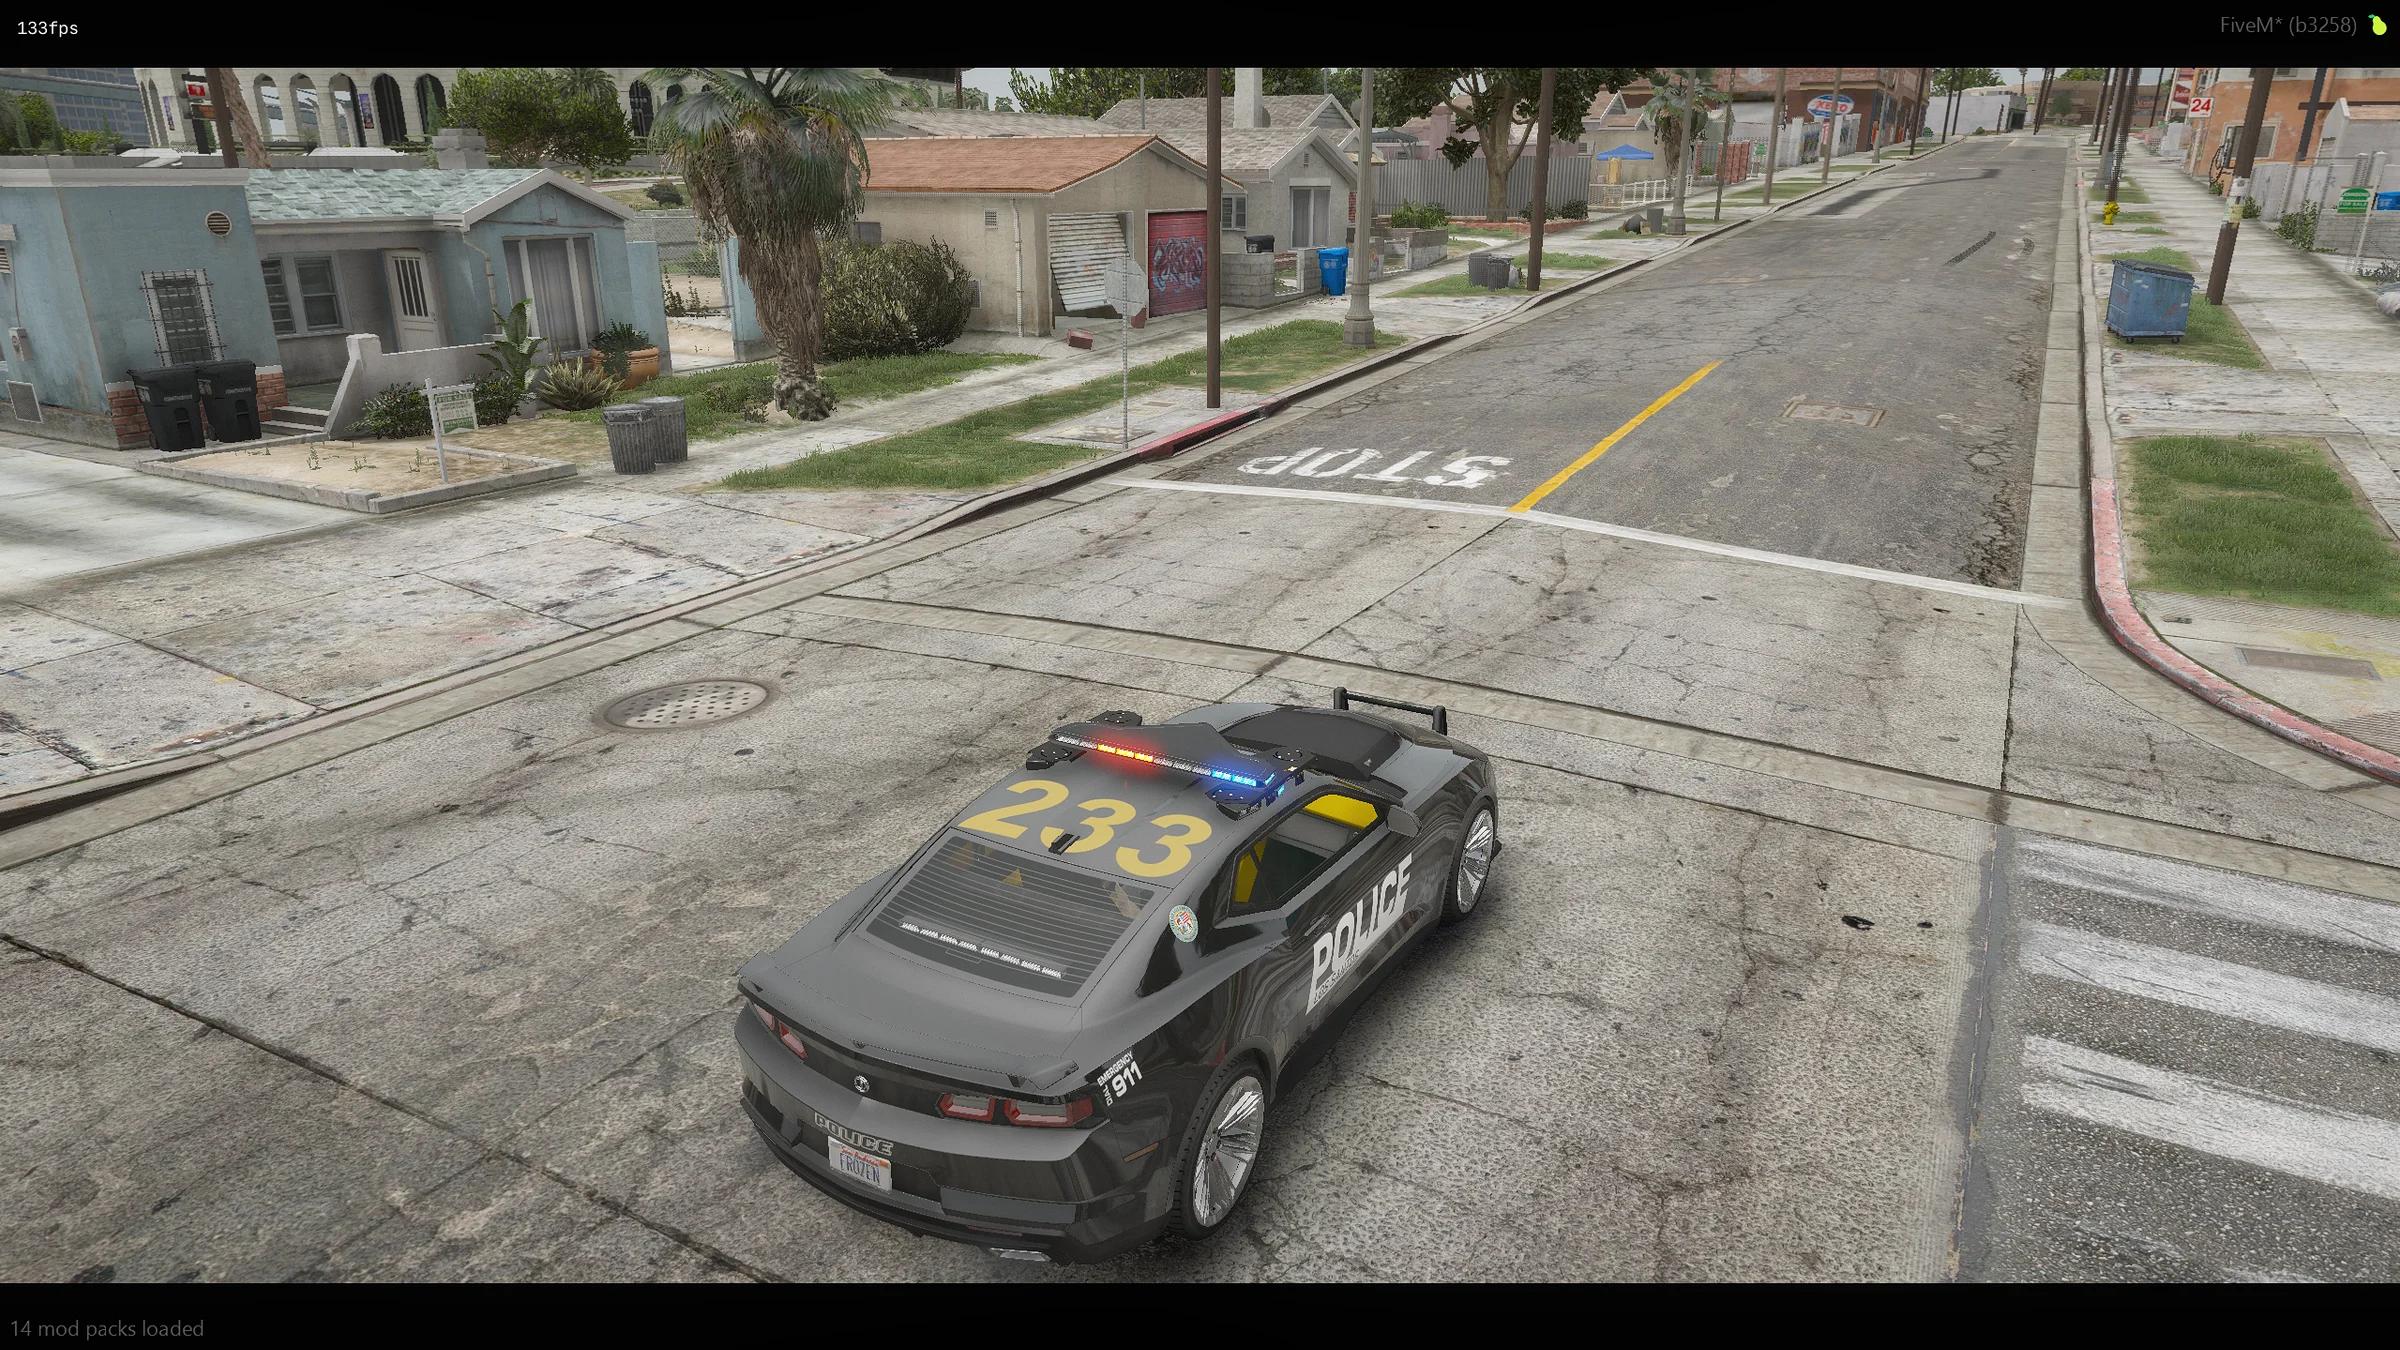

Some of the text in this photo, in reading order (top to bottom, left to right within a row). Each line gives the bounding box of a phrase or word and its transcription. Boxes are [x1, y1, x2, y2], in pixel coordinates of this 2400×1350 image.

[1814, 100, 1849, 113] XEO
[2190, 98, 2211, 113] 24
[1237, 447, 1513, 489] STOP
[957, 779, 1212, 878] 233
[1306, 853, 1412, 1015] POLICE
[1096, 1050, 1134, 1087] EMERGENCY
[1111, 1060, 1143, 1098] 911
[1102, 1084, 1114, 1107] DIAL
[814, 1111, 895, 1157] POLICE
[840, 1152, 881, 1184] FROZEN
